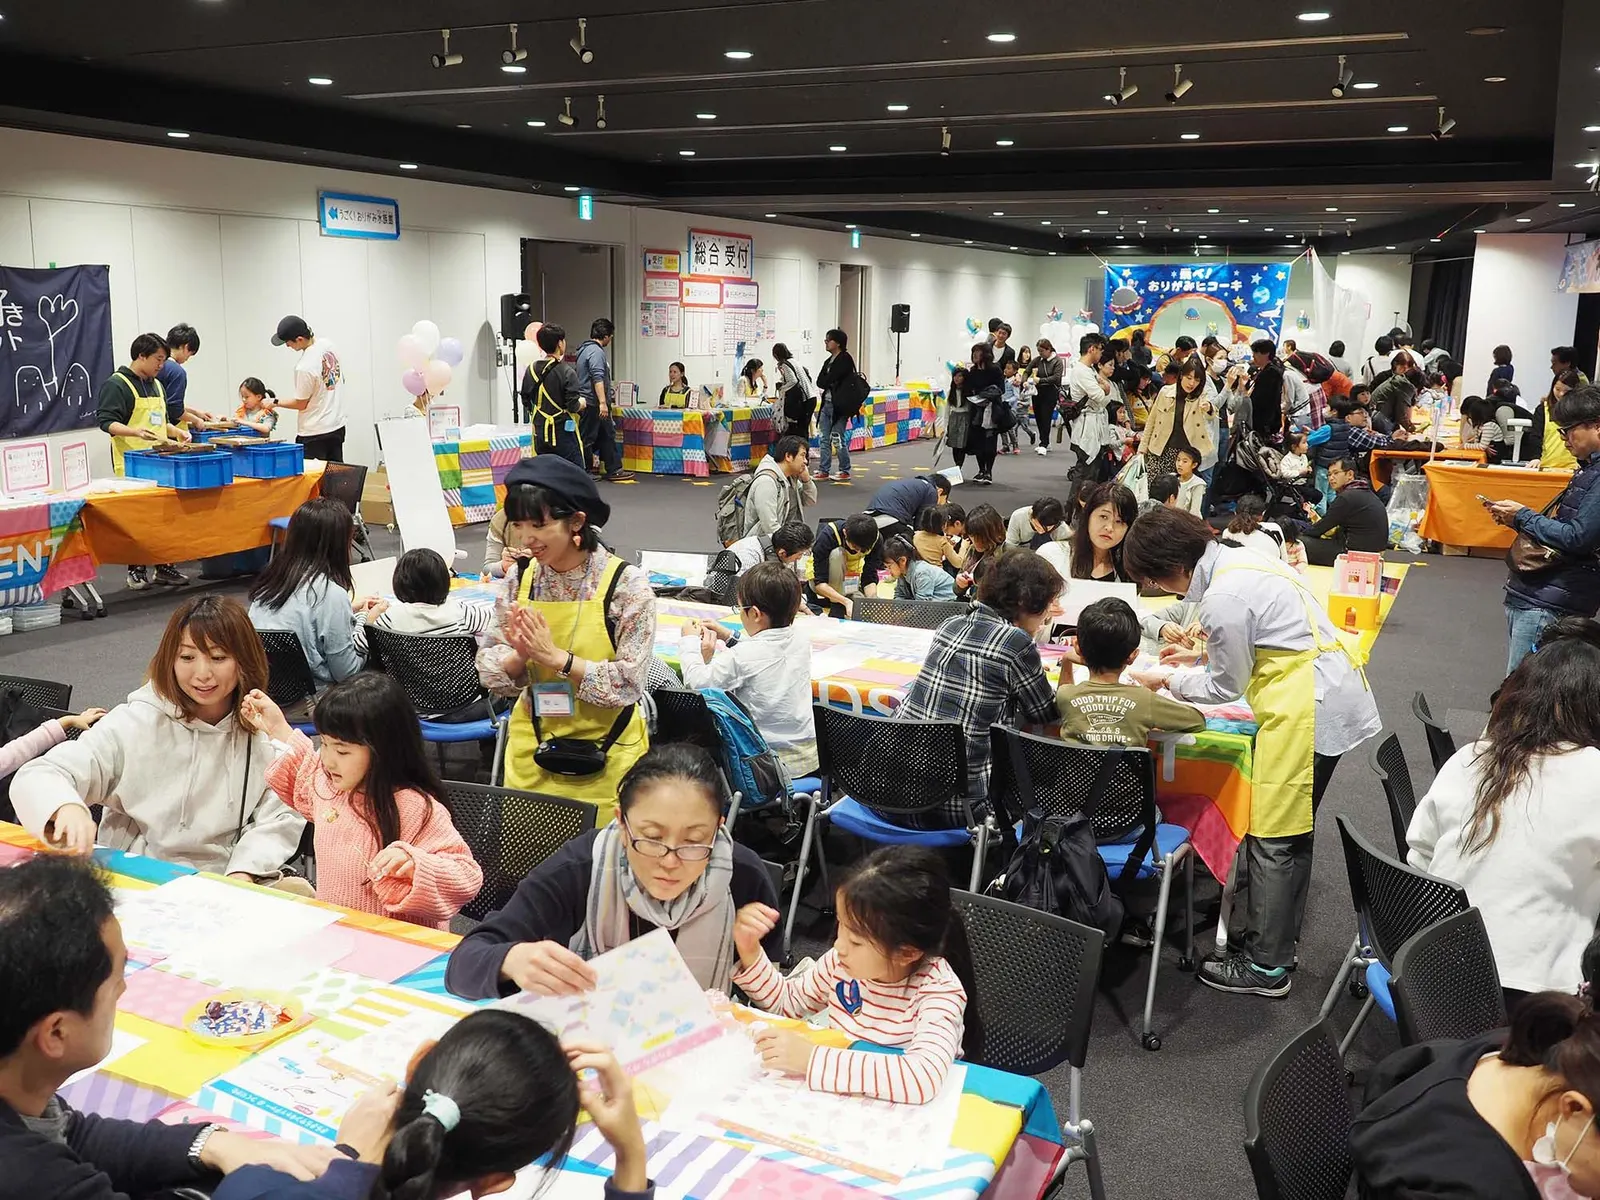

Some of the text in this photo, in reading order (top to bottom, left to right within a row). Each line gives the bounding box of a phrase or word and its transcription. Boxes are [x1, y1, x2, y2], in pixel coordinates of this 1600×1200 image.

[1148, 280, 1243, 292] おりがみヒコーキ
[1070, 694, 1137, 710] GOOD TRIP FOR
[1080, 703, 1128, 716] GOOD LIFE
